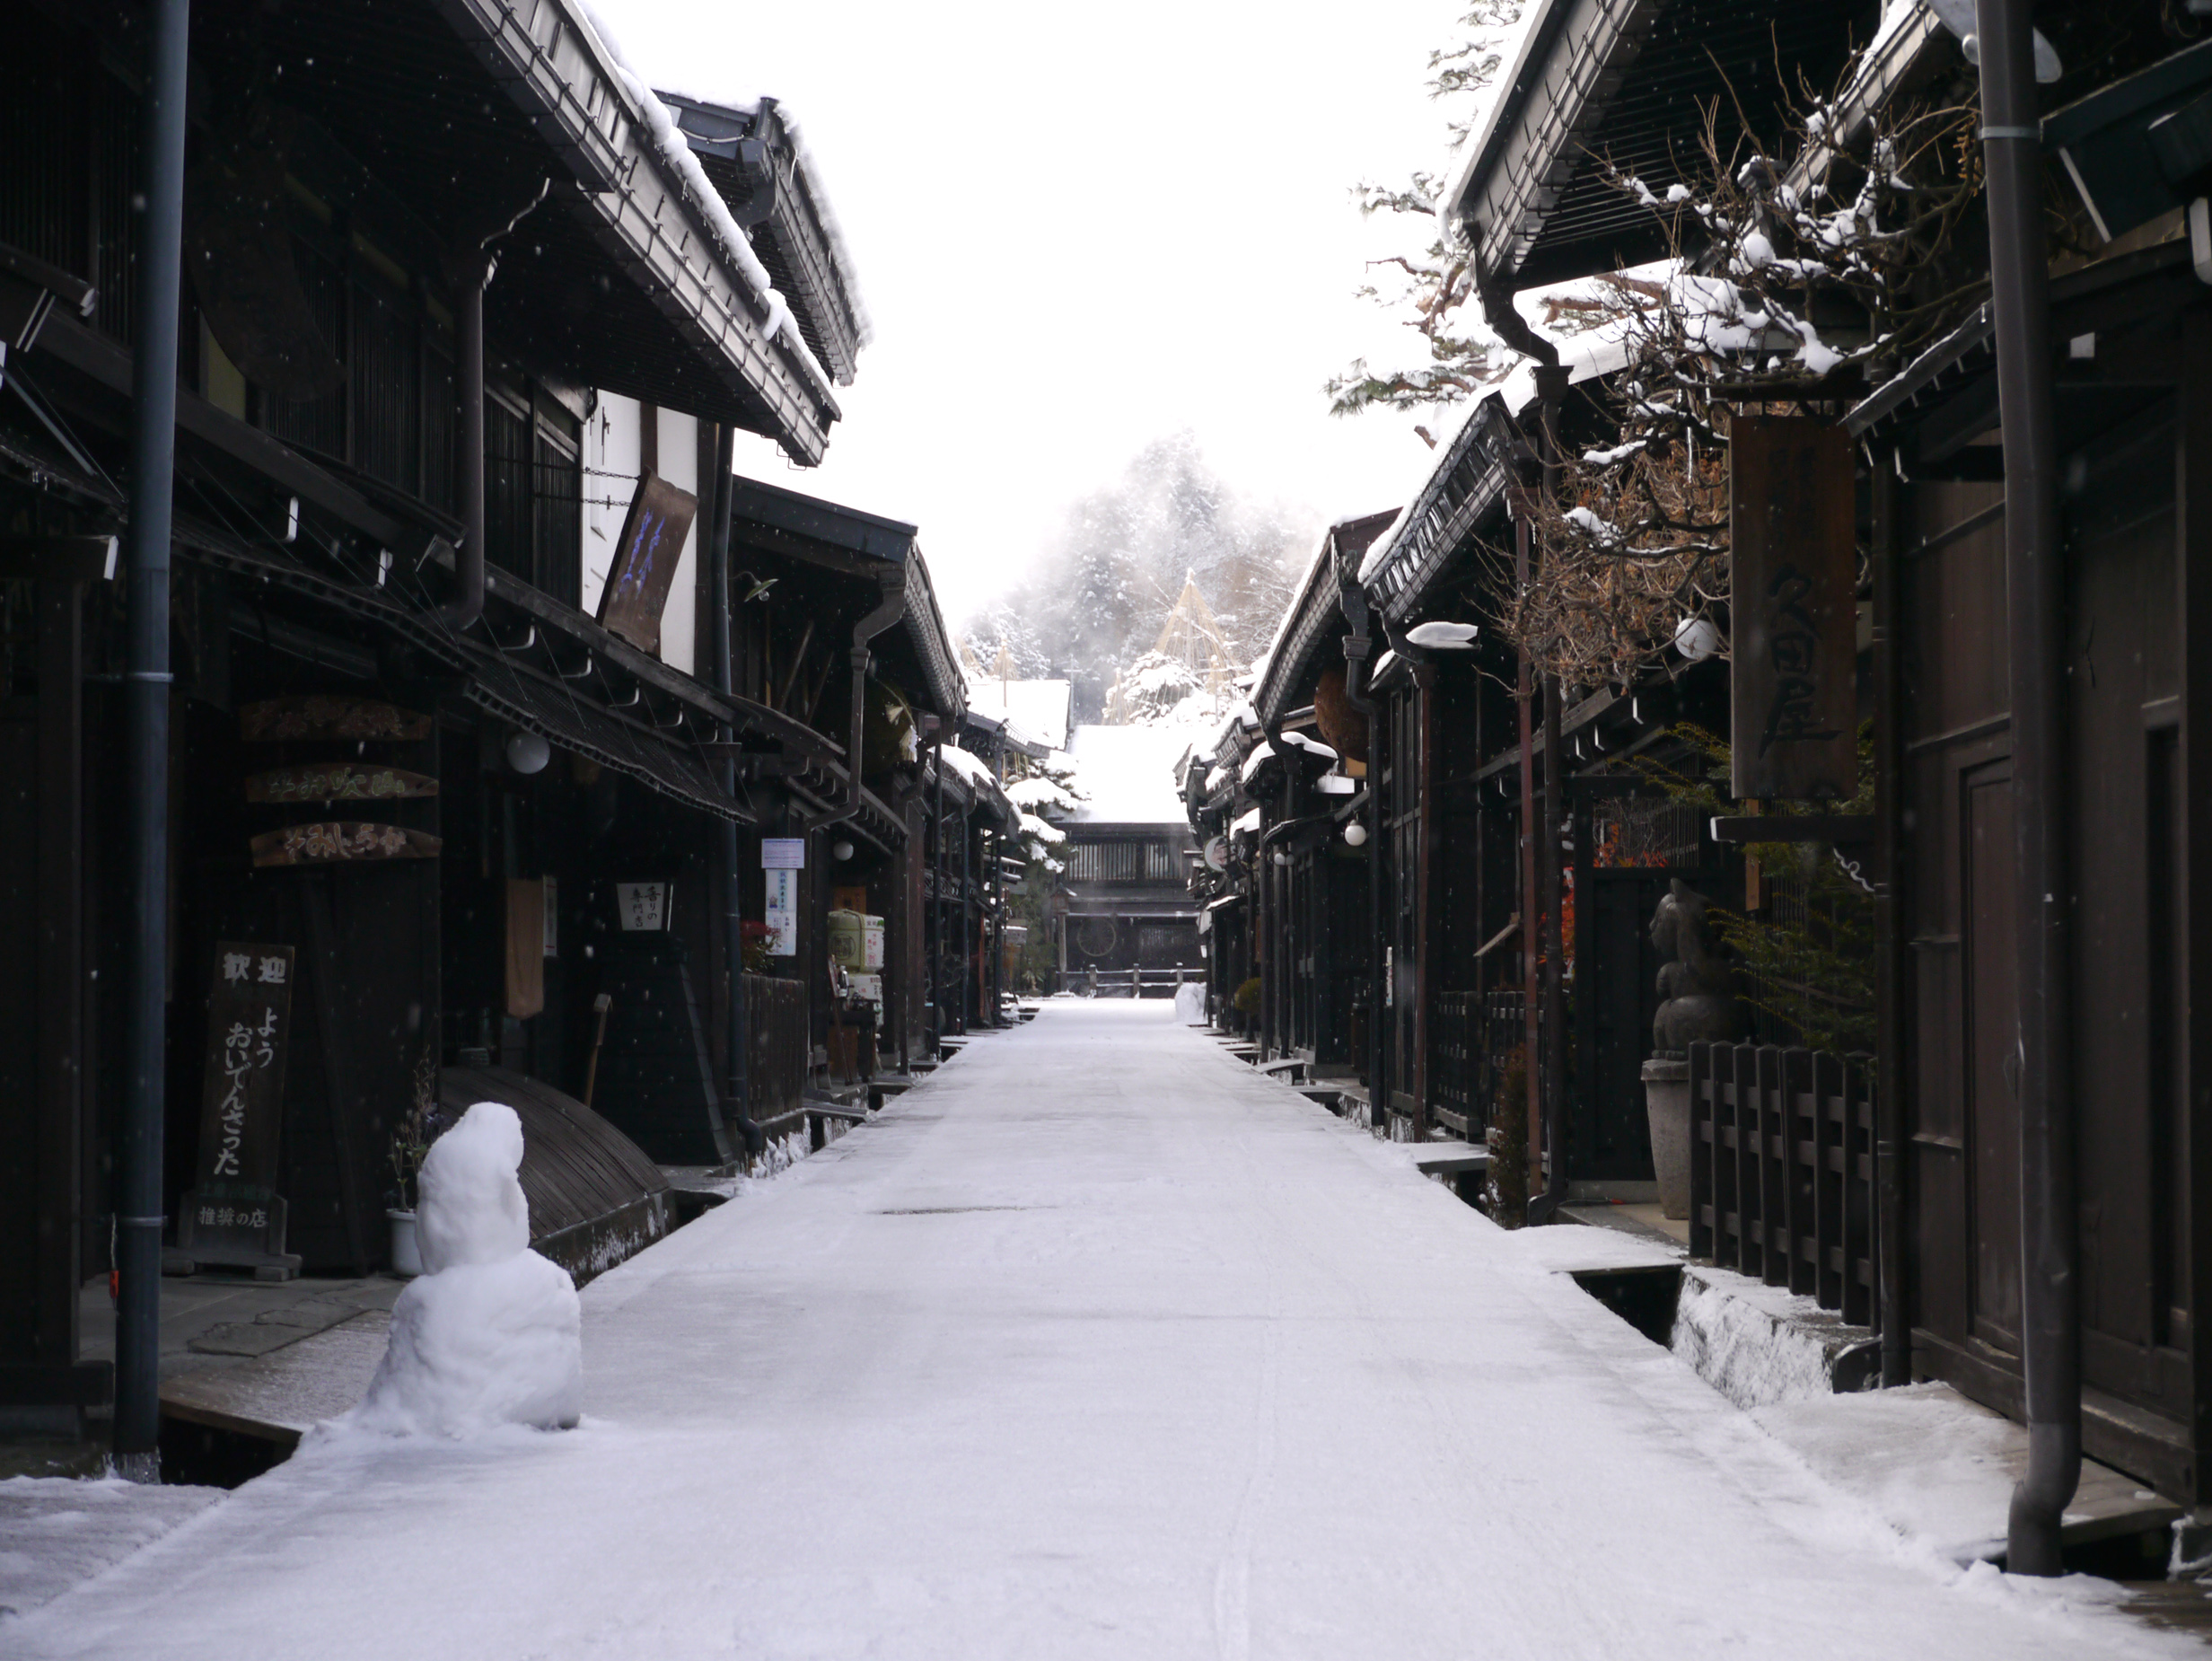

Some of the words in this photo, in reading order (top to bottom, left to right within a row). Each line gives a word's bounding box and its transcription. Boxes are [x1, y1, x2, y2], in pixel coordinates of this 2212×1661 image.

[1758, 562, 1845, 760] 久田屋
[644, 885, 662, 920] 香りの
[223, 952, 286, 985] 歓迎
[257, 1006, 278, 1069] よう
[214, 1022, 254, 1175] おいでんさった
[198, 1205, 269, 1229] 推奨の店
